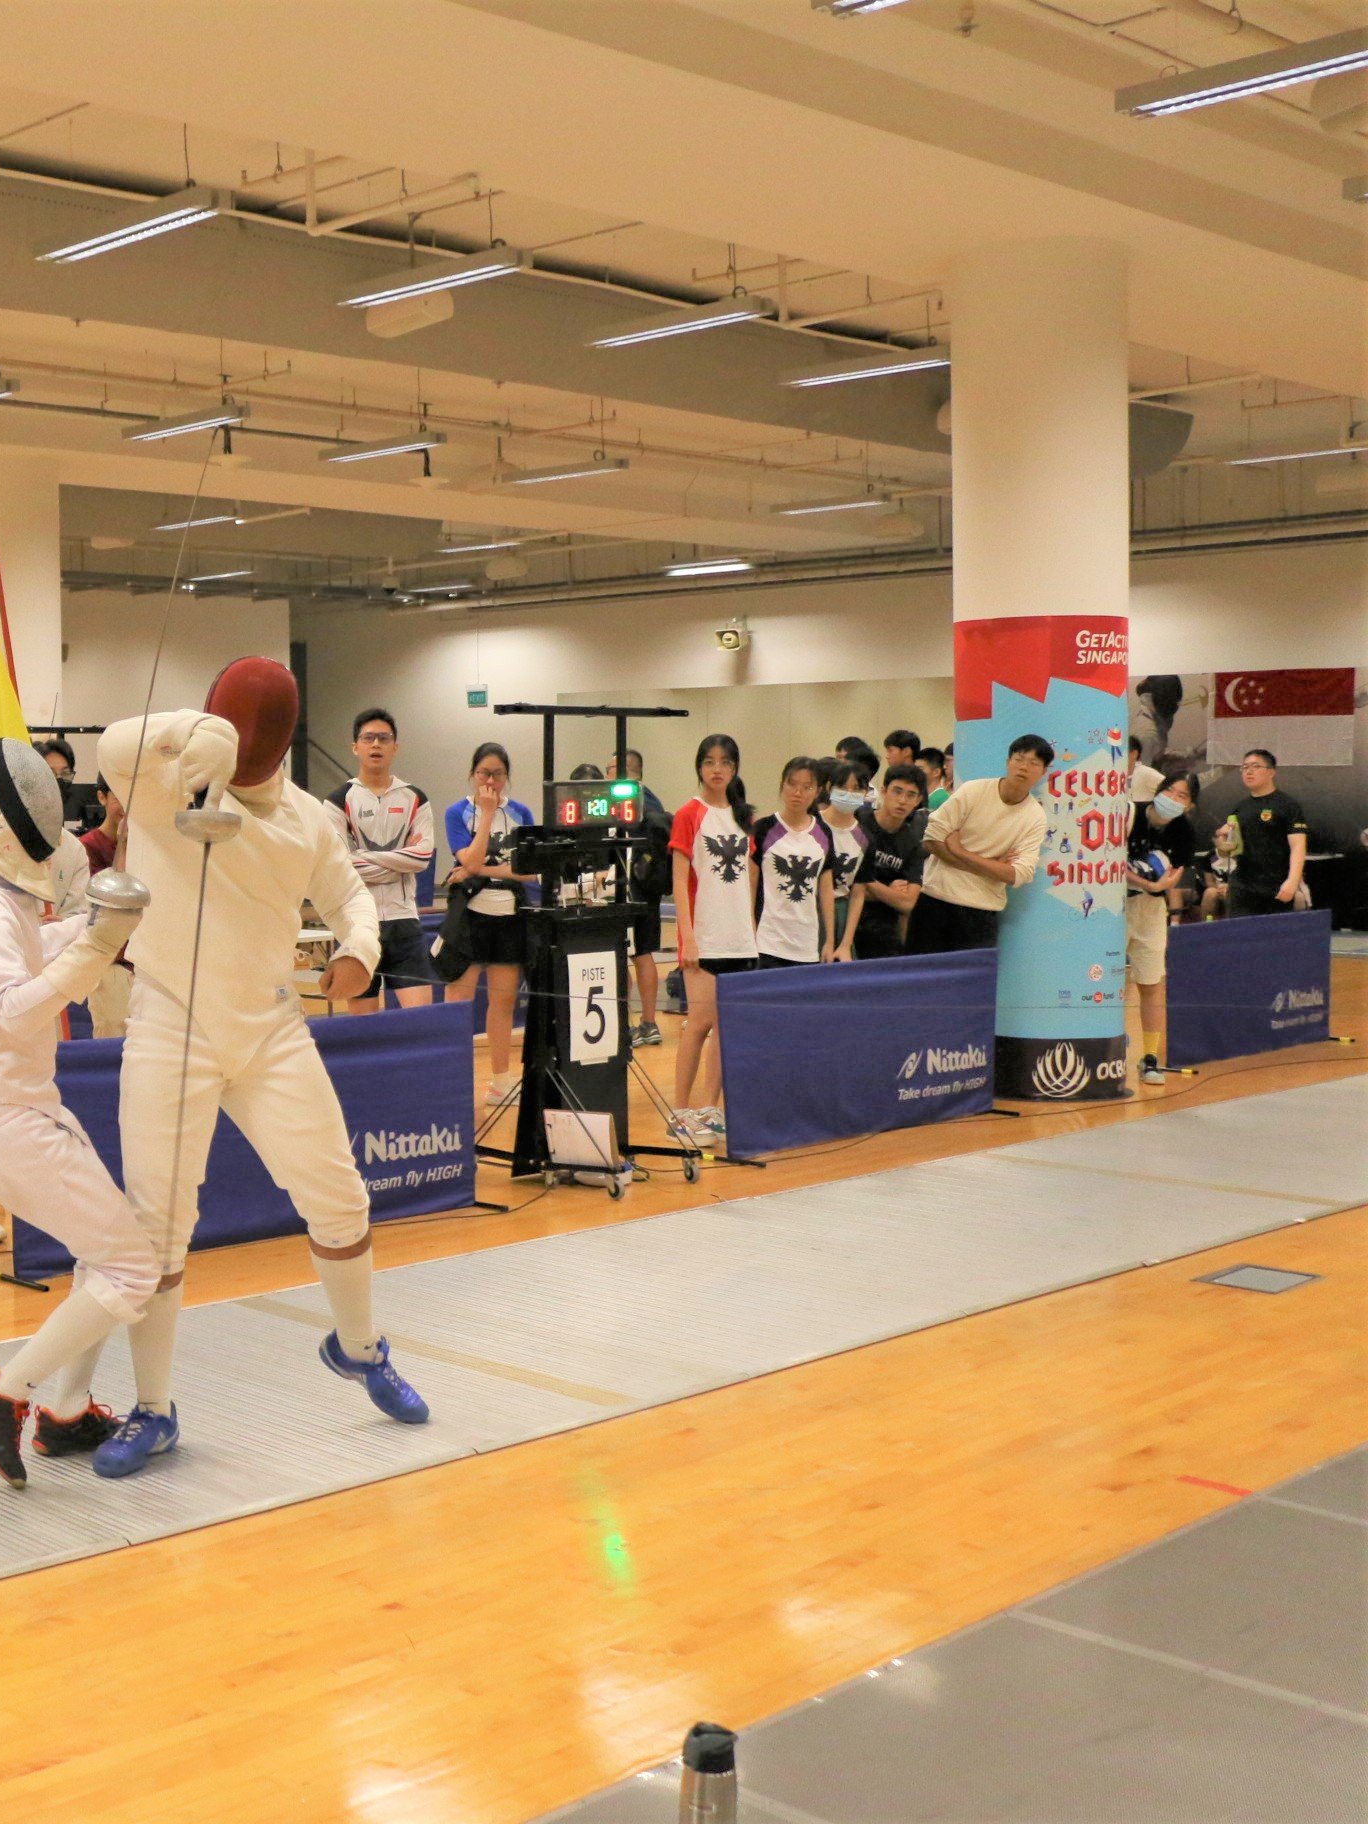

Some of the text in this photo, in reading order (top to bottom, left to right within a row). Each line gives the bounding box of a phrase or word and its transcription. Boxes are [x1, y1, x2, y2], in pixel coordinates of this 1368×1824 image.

[566, 801, 576, 823] 8
[624, 800, 633, 821] 6
[582, 967, 606, 981] PISTE
[583, 986, 606, 1045] 5
[926, 1043, 987, 1075] Nittaku
[897, 1086, 921, 1100] Take
[922, 1084, 951, 1098] dream
[364, 1123, 463, 1165] Nittaku
[405, 1170, 424, 1188] fly
[425, 1164, 463, 1182] HIGH
